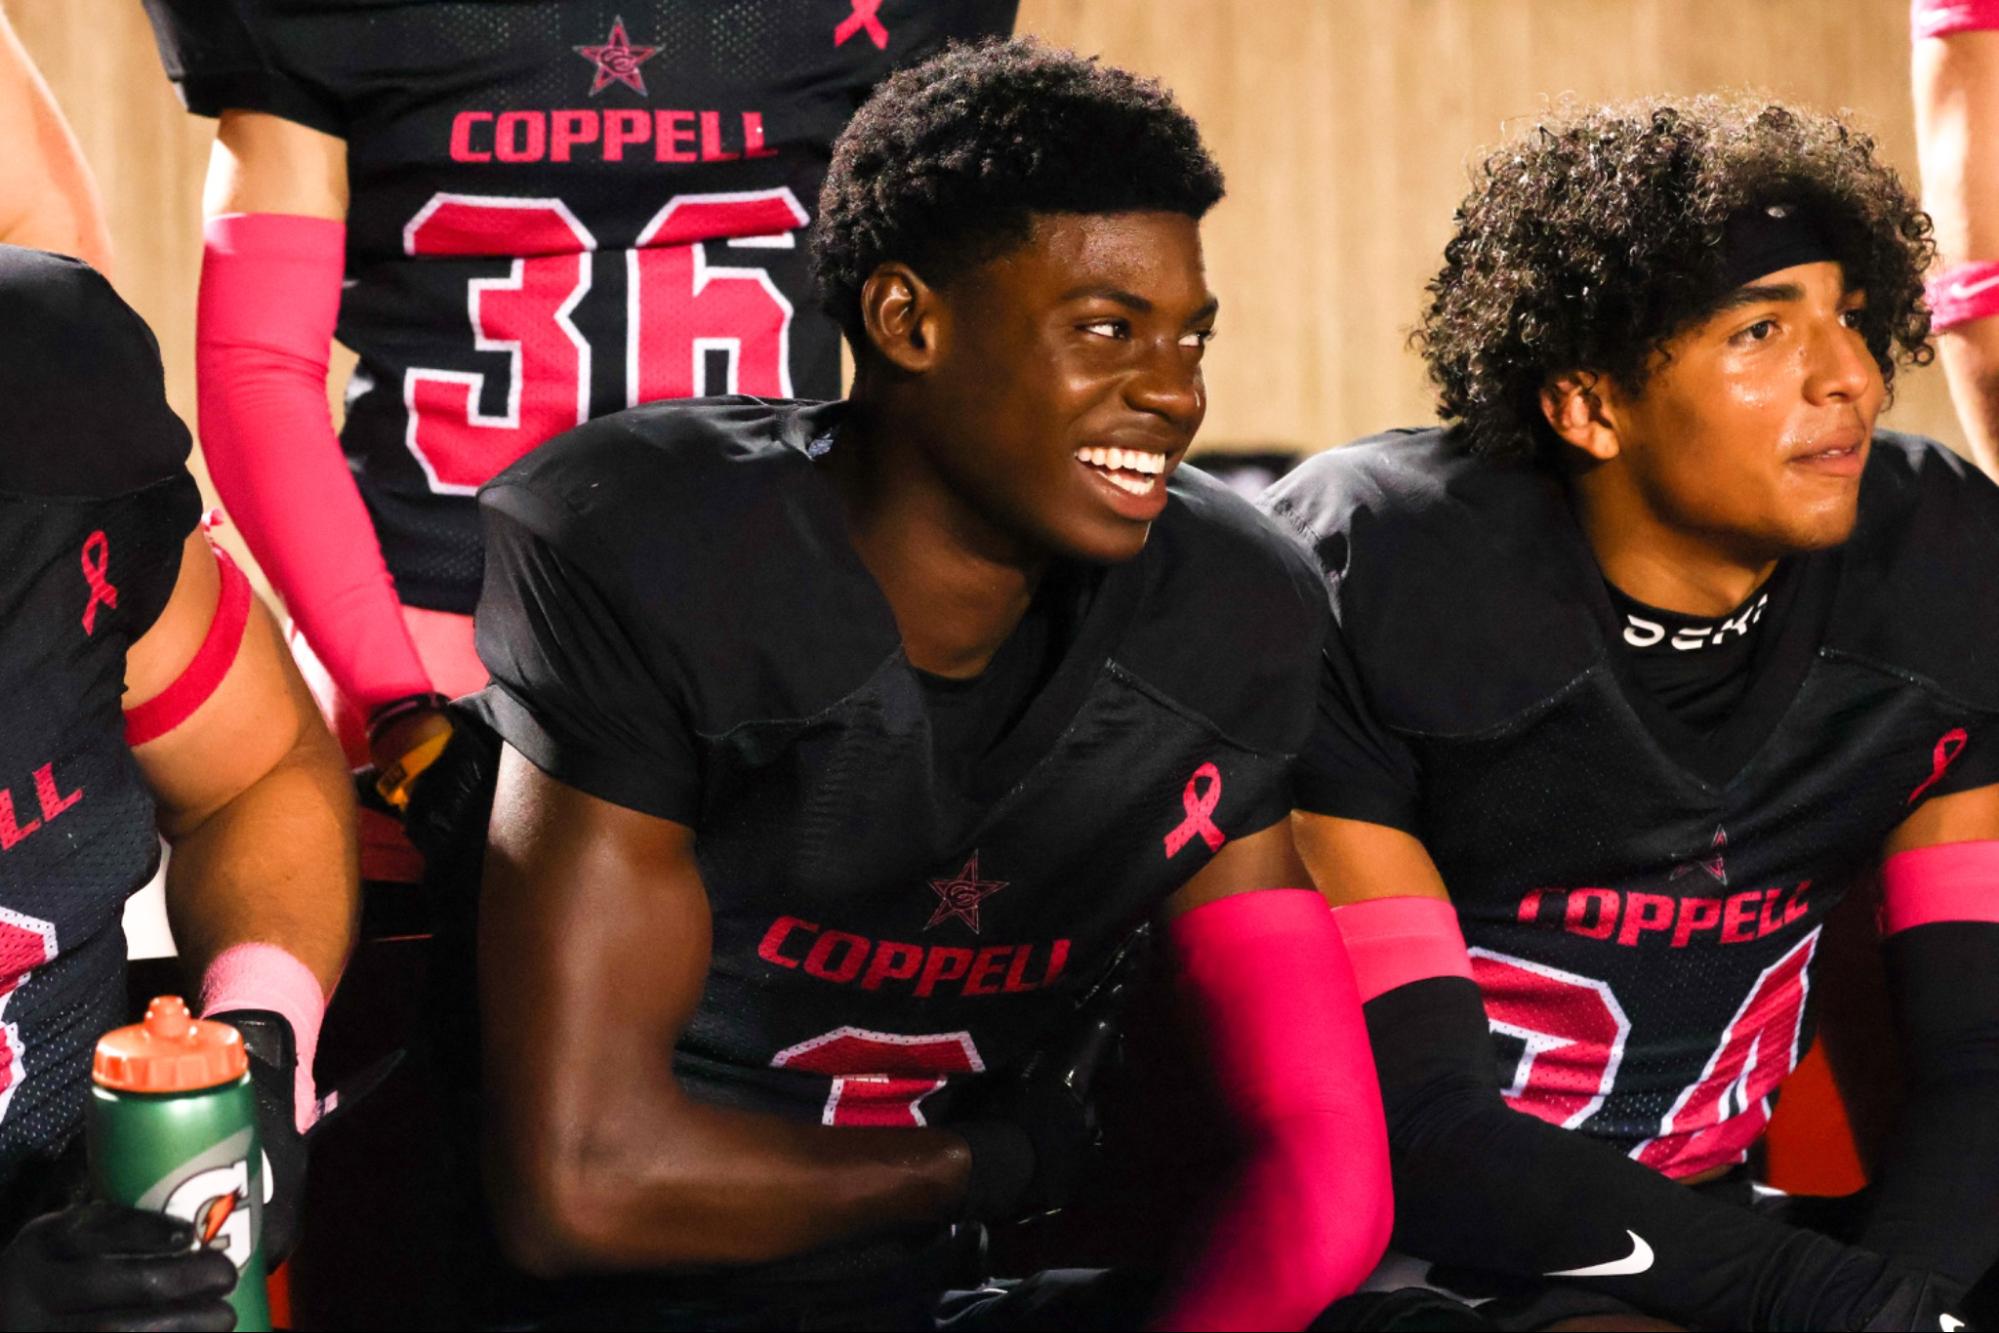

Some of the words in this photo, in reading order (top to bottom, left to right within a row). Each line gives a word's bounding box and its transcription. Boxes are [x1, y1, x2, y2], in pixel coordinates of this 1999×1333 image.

[449, 108, 778, 163] COPPELL
[403, 187, 810, 497] 36
[757, 915, 1071, 997] COPPELL
